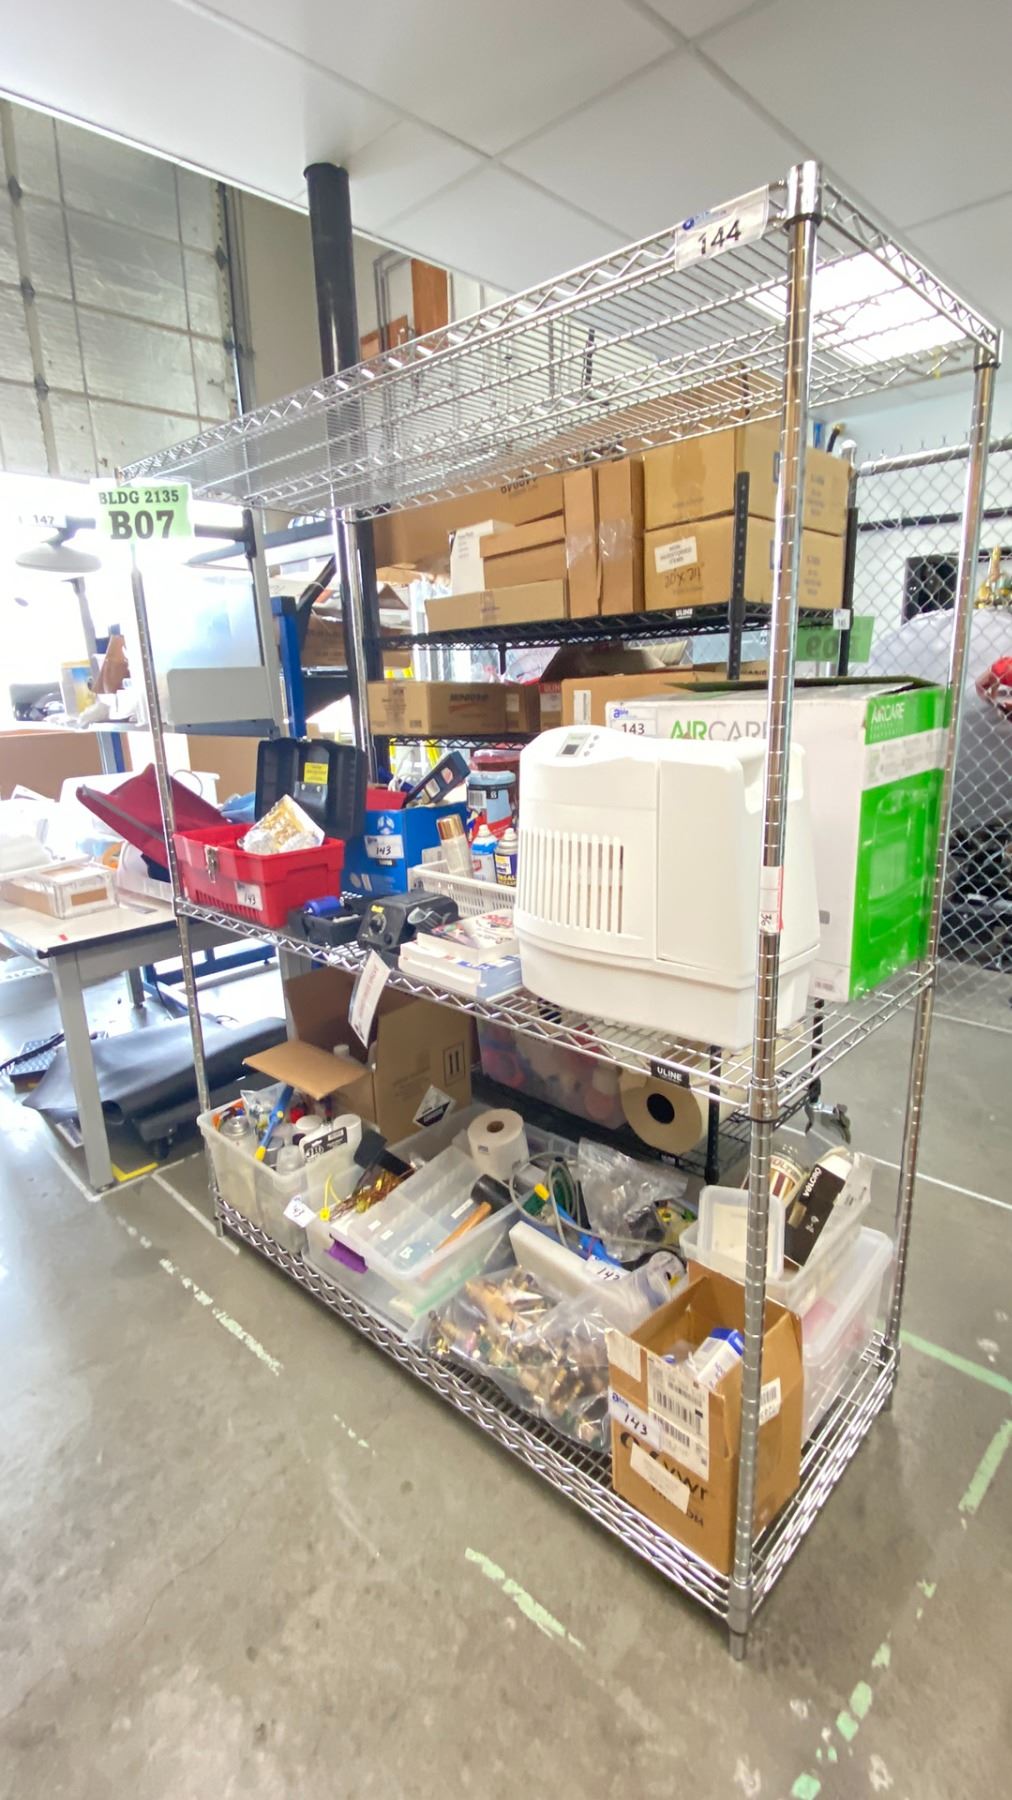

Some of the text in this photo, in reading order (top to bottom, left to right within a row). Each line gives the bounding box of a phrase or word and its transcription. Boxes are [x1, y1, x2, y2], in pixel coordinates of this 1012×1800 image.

[699, 219, 742, 255] 144
[99, 489, 180, 505] BLDG 2135
[34, 514, 55, 525] 147
[108, 510, 175, 540] B07
[621, 722, 645, 735] 143
[671, 719, 768, 742] AIRCAR
[376, 845, 392, 856] 143
[656, 1065, 683, 1082] ULINE
[625, 1413, 648, 1435] 143
